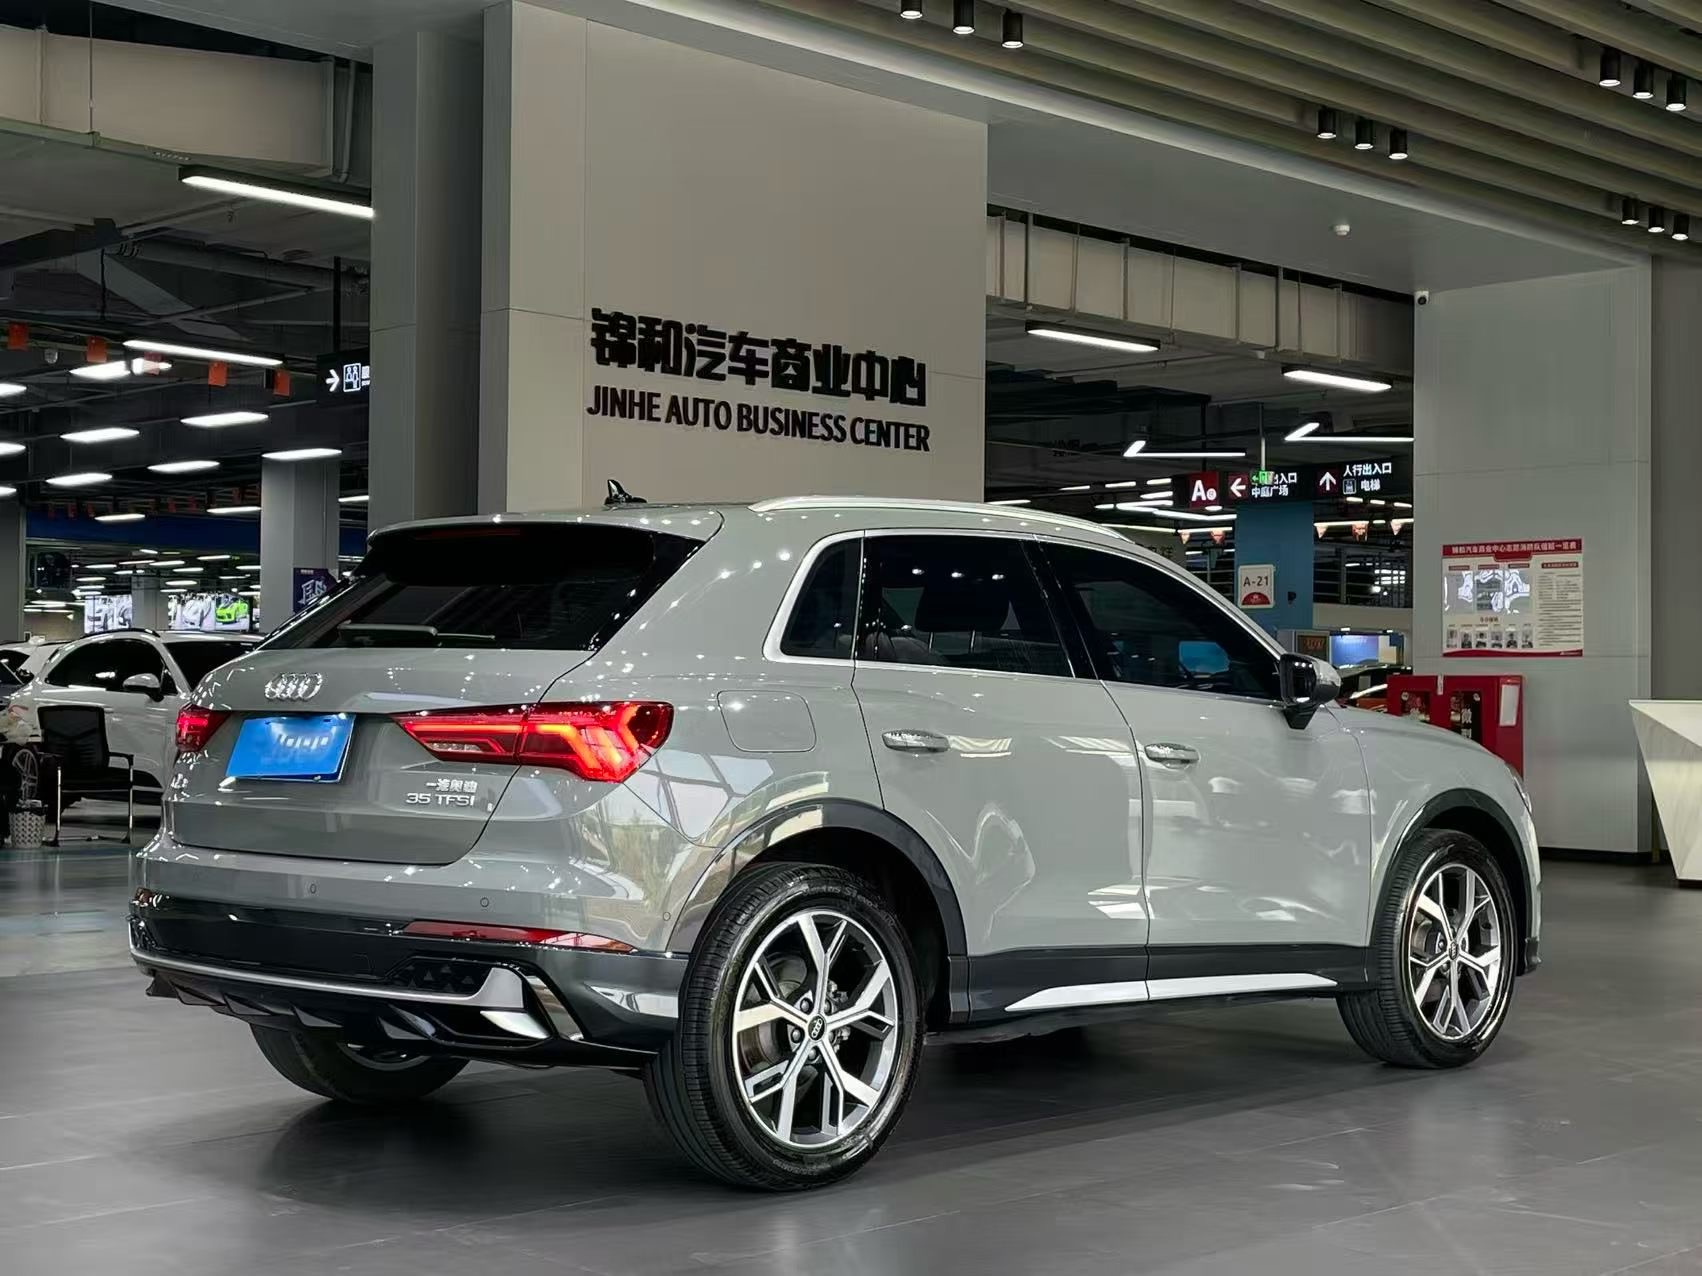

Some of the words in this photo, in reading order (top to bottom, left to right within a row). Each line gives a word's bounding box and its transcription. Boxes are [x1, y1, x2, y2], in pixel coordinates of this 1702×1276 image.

[591, 307, 927, 407] 锦和汽车商业中心
[586, 385, 662, 423] JINHE
[665, 395, 732, 431] AUTO
[737, 403, 847, 444] BUSINESS
[850, 417, 931, 452] CENTER
[1343, 462, 1392, 477] 人行出入口
[1251, 485, 1289, 498] 中庭广场
[1360, 478, 1381, 492] 电梯
[1243, 576, 1269, 587] A-21
[425, 778, 478, 793] 一汽奥迪
[405, 792, 431, 805] 35
[435, 794, 476, 807] TFSI
